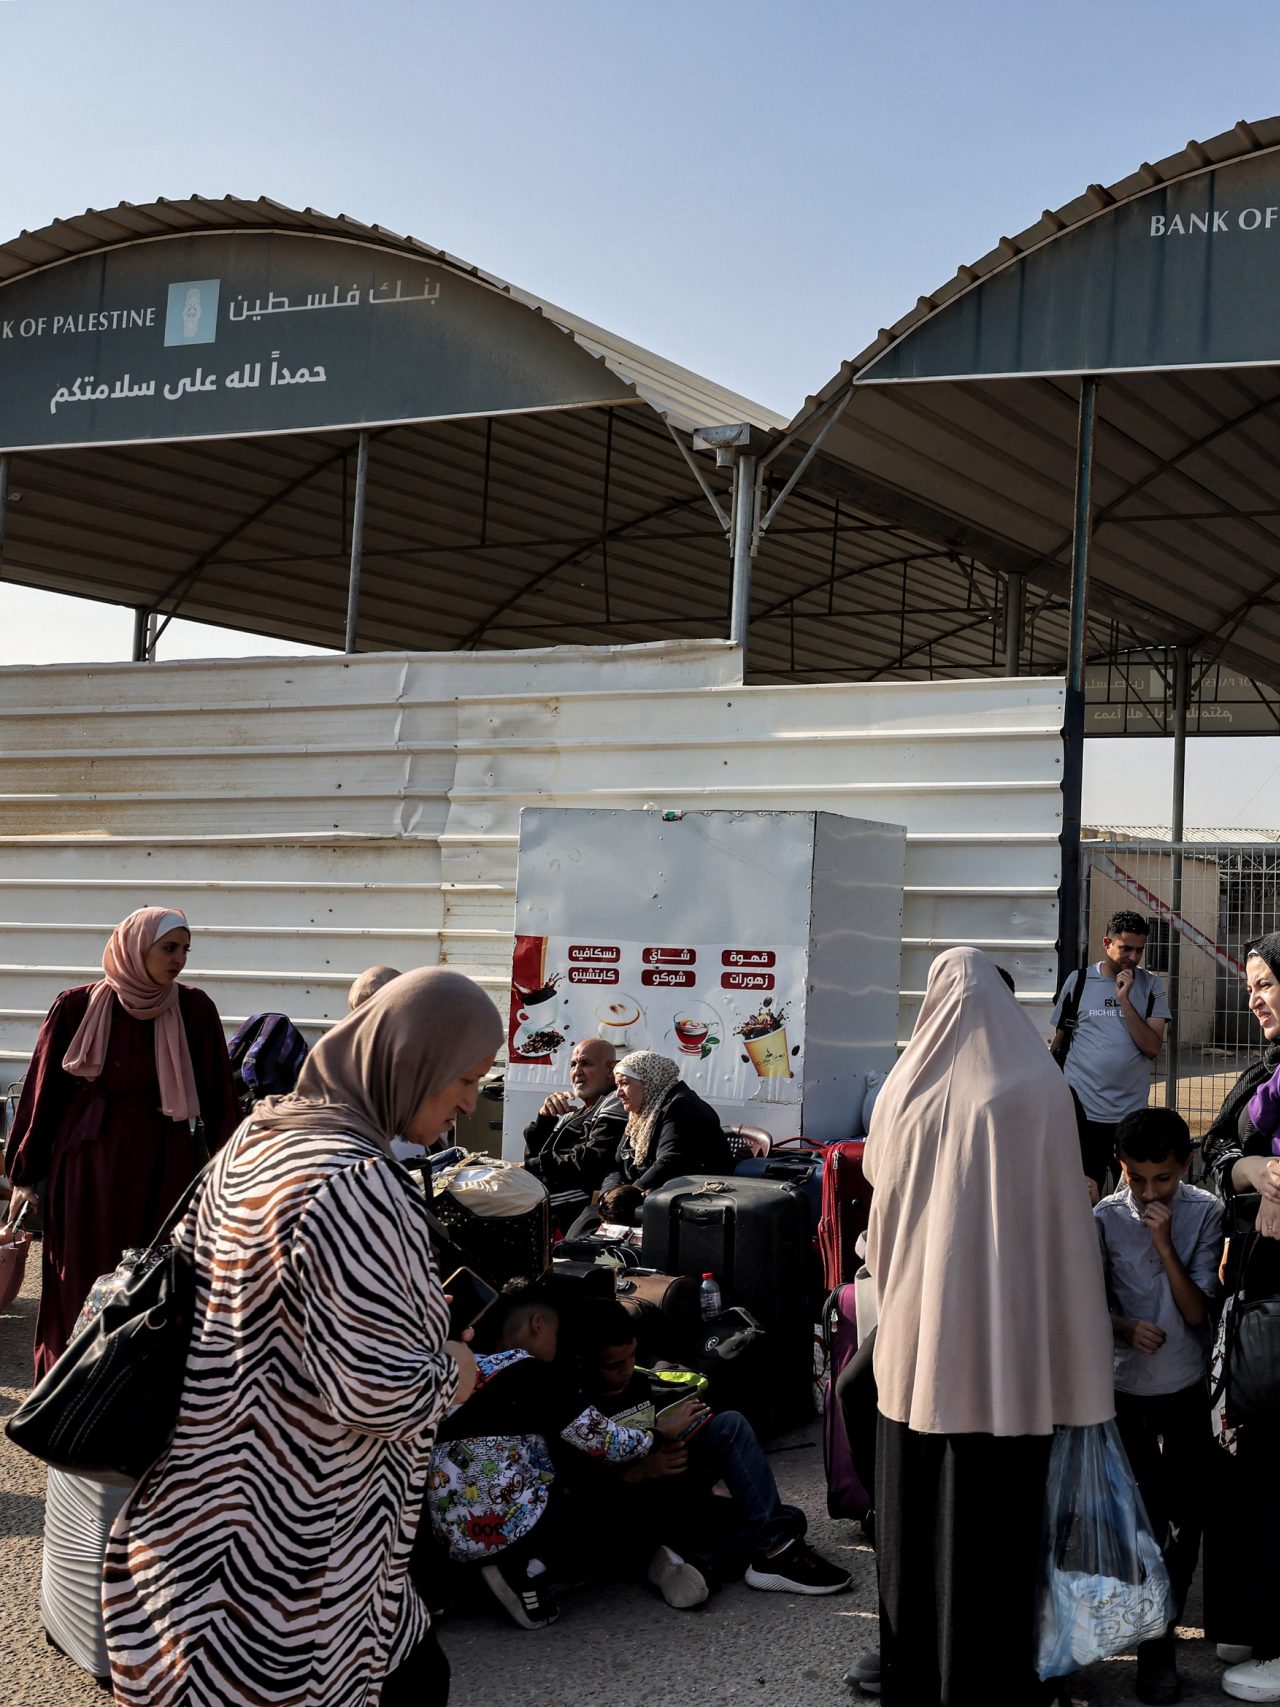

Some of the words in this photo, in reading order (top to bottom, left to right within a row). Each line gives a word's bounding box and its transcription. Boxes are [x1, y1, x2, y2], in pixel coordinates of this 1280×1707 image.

[1150, 210, 1229, 237] BANK
[1238, 207, 1278, 231] OF
[229, 284, 361, 321] فلسطين
[369, 277, 441, 305] بنك
[20, 317, 47, 337] OF
[53, 307, 156, 335] PALESTINE
[163, 368, 217, 400] على
[225, 363, 261, 388] لله
[50, 374, 156, 415] سلامتكم
[572, 948, 617, 961] نسكافيه
[650, 949, 690, 964] شاي
[730, 952, 768, 966] قهوة
[572, 970, 616, 982] كابتشينو
[652, 972, 686, 985] شوكو
[730, 974, 768, 988] زهورات
